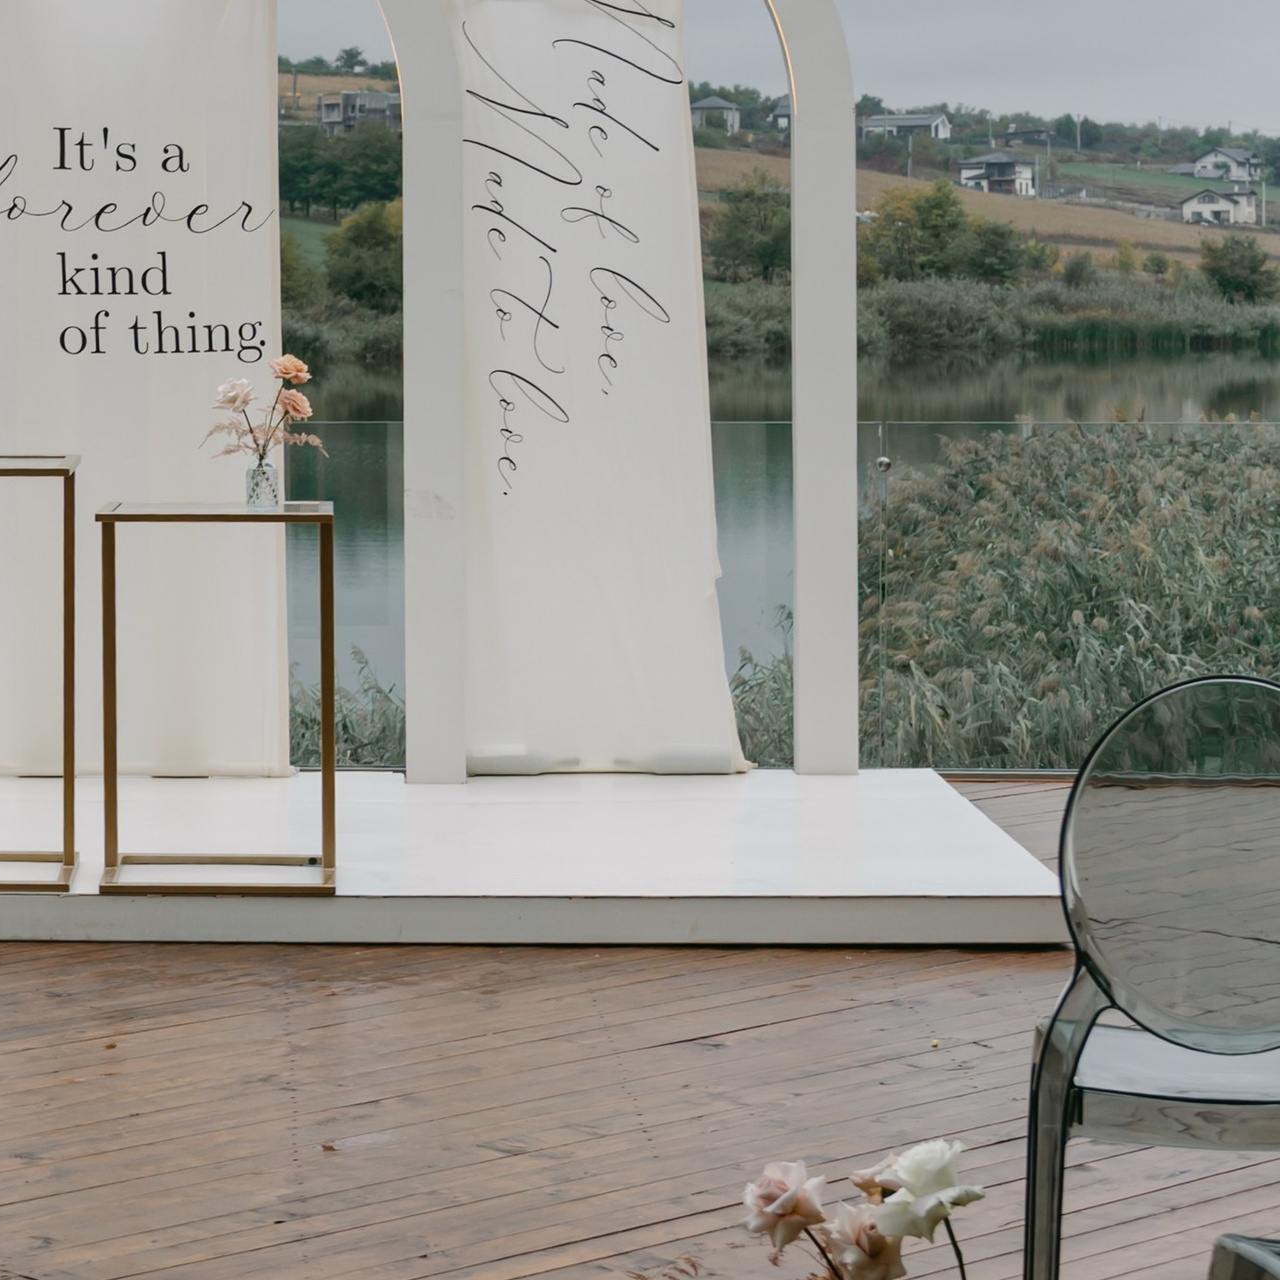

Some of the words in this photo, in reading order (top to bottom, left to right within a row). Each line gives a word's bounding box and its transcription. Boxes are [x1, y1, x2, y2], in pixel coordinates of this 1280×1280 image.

[52, 126, 138, 173] It's
[160, 143, 191, 173] a
[461, 20, 583, 261] Made
[560, 184, 640, 243] of
[56, 251, 172, 296] kind
[59, 309, 110, 355] of
[128, 310, 267, 364] thing.
[490, 256, 565, 373] to
[488, 369, 570, 496] love.
